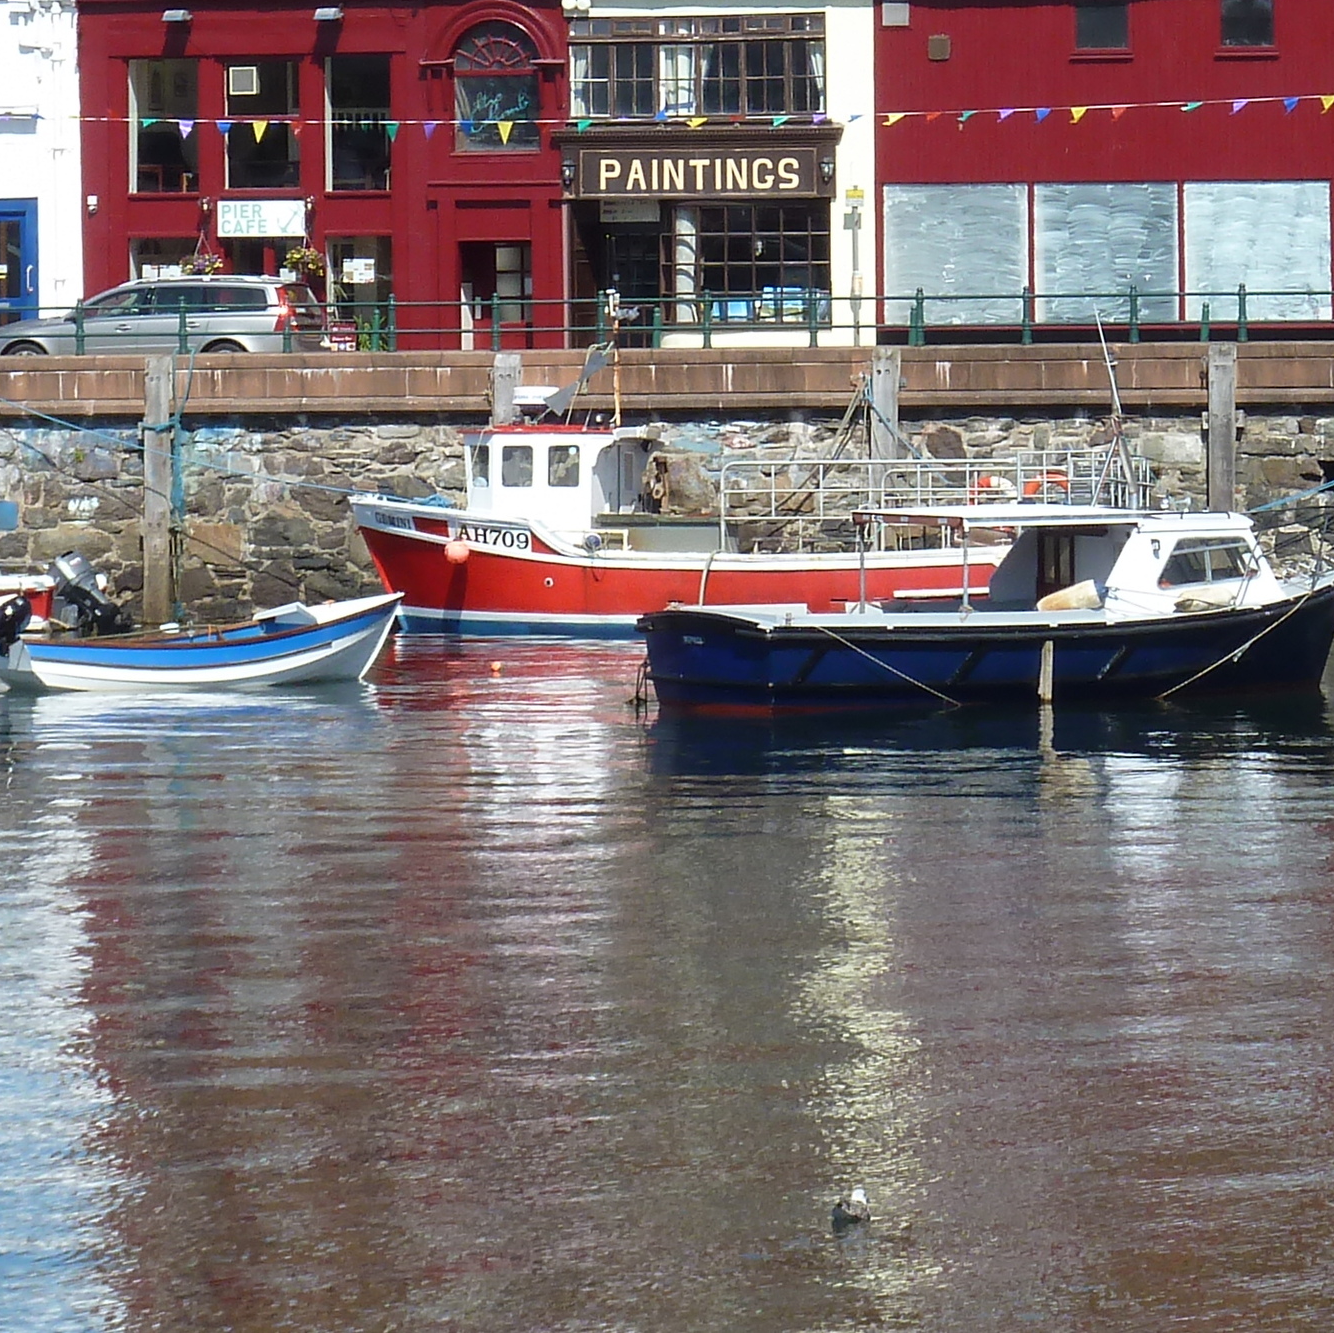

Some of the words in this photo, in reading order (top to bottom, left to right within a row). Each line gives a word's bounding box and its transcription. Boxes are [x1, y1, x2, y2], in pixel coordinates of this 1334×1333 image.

[598, 157, 801, 192] PAINTINGS
[221, 204, 263, 219] PIER
[221, 219, 268, 234] CAFE
[374, 512, 412, 530] GEMINI
[458, 523, 530, 550] AH709
